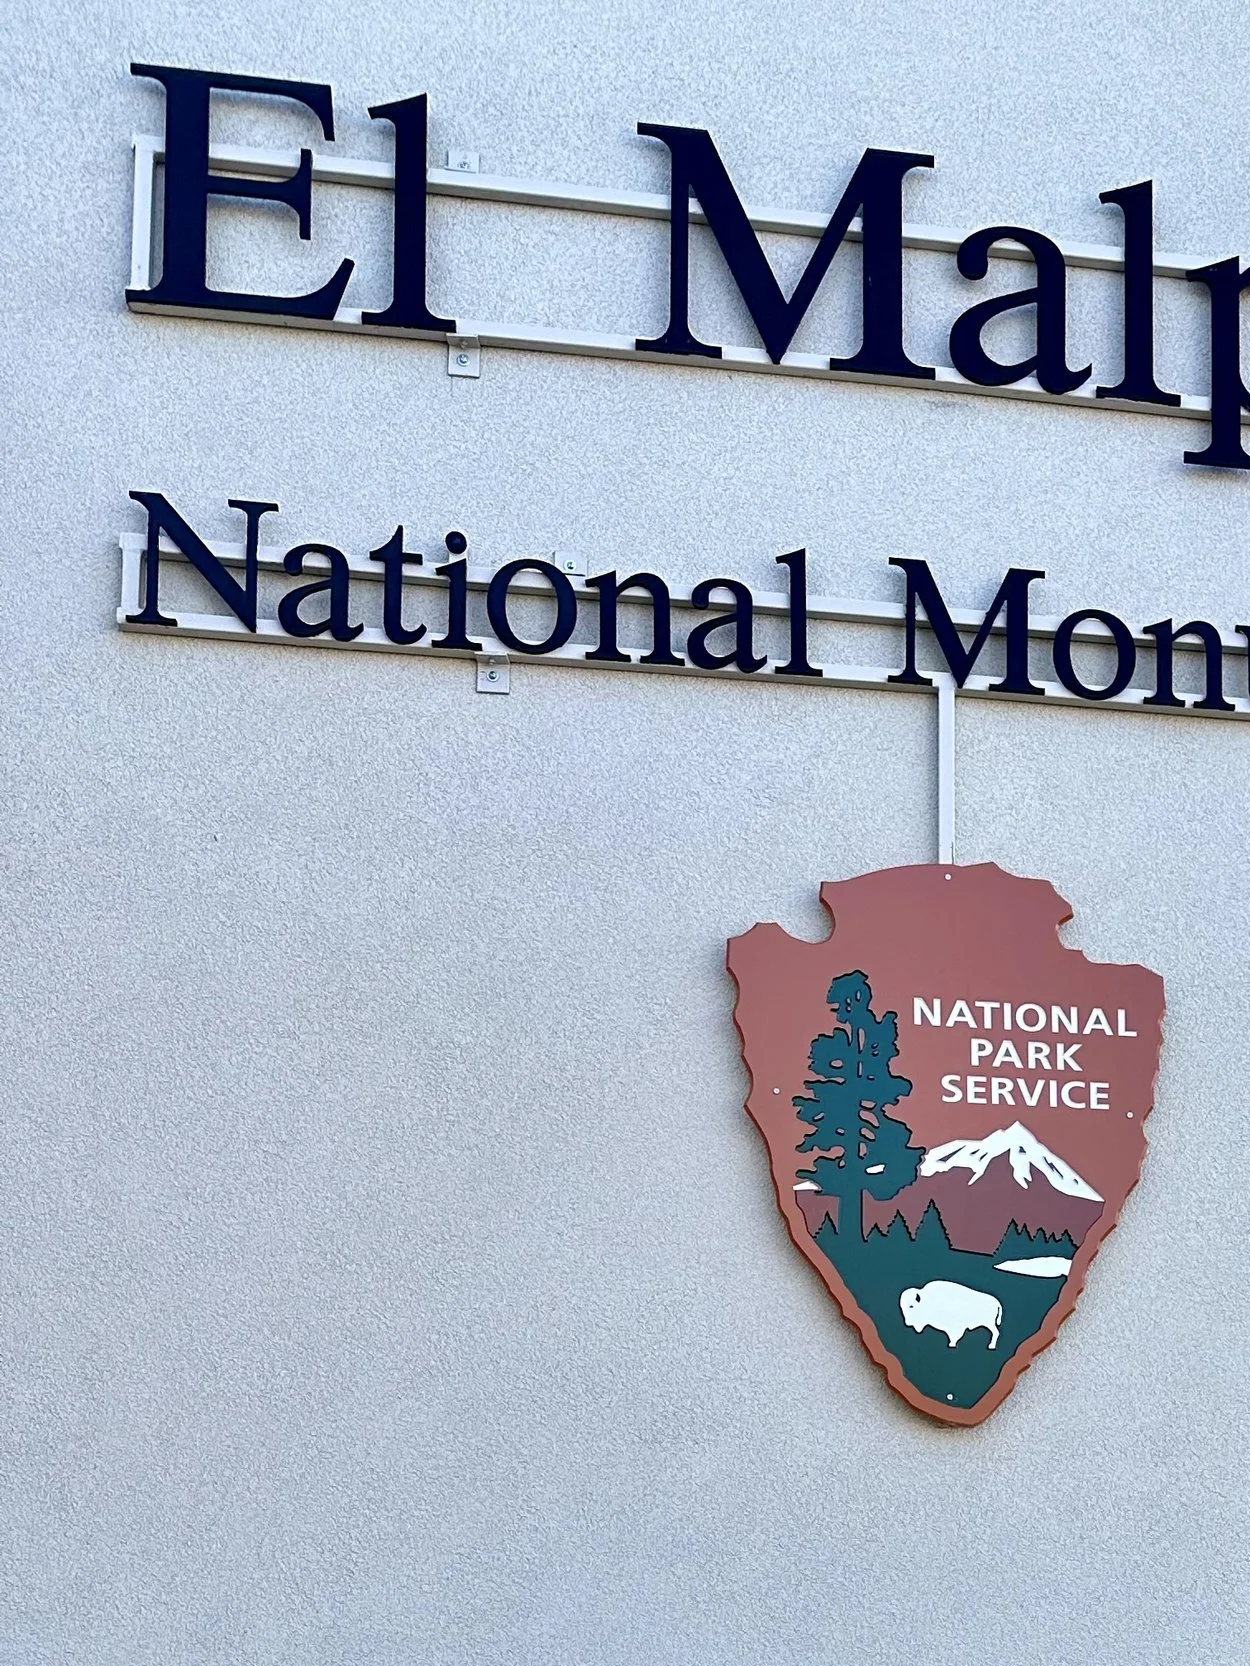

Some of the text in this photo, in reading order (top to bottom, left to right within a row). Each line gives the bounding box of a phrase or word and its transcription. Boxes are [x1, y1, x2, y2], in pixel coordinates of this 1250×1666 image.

[125, 62, 457, 332] El
[125, 490, 823, 678] National
[912, 997, 1138, 1037] NATIONAL
[970, 1038, 1083, 1072] PARK
[940, 1075, 1110, 1110] SERVICE
